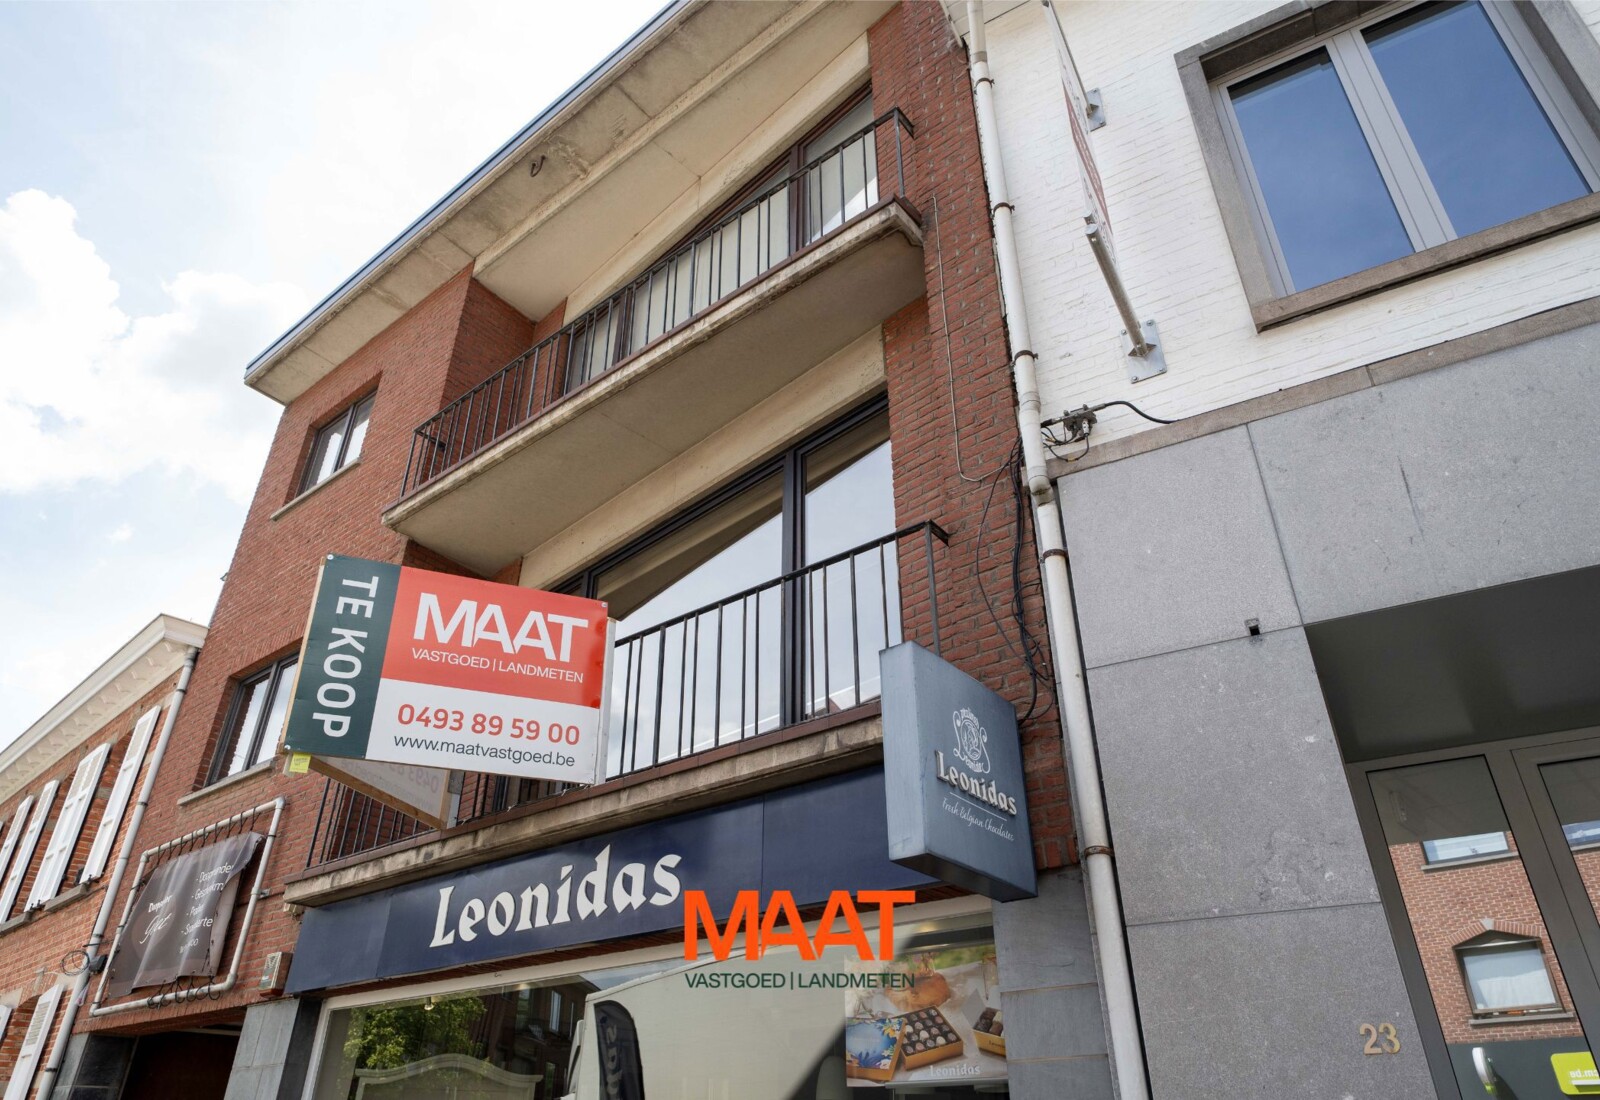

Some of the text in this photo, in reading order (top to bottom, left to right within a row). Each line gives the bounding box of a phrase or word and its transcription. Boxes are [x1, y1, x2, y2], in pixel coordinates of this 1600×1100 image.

[413, 592, 589, 663] MAAT
[312, 576, 379, 738] TE KOOP
[411, 647, 584, 683] VASTGOED LANDMETEN
[397, 703, 580, 745] 0493 89 59 00
[393, 735, 575, 767] www.maatvastgoed.be
[935, 750, 1017, 816] Leonidas
[942, 797, 1015, 841] Fresh Belgian Chocolates
[428, 843, 682, 949] Leonidas
[1359, 1022, 1402, 1056] 23
[929, 1063, 982, 1078] Leonidas
